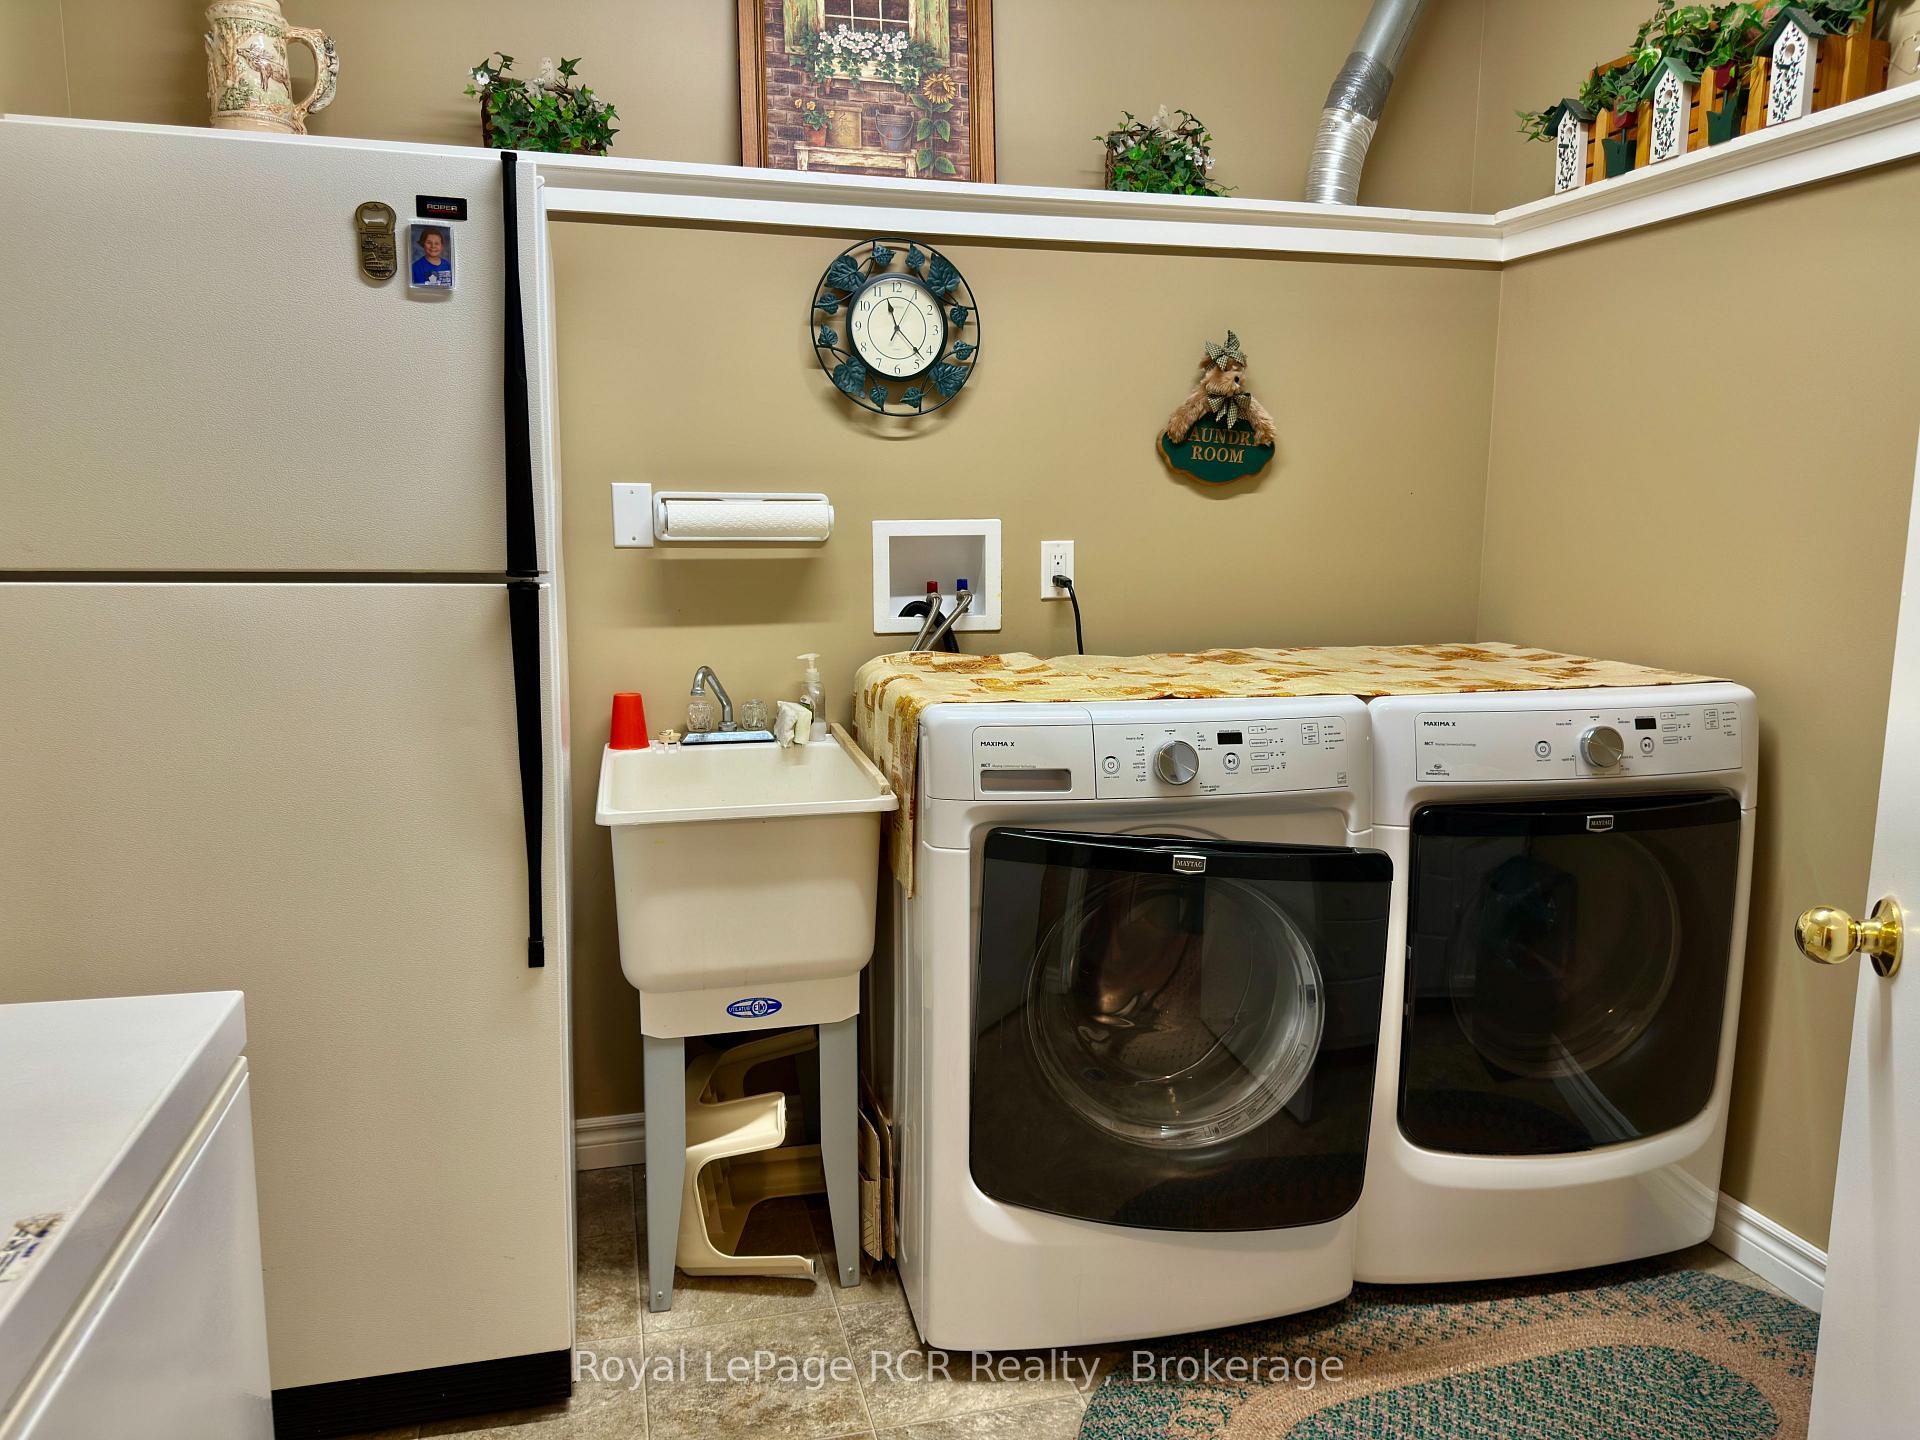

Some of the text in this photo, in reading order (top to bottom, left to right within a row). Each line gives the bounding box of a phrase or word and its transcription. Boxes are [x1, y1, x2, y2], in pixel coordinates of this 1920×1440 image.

[426, 203, 458, 213] ROPER
[873, 286, 882, 297] 11
[892, 282, 902, 293] 12
[860, 300, 871, 311] 10
[927, 305, 933, 315] 2
[855, 321, 862, 331] 9
[933, 325, 939, 336] 3
[860, 342, 867, 352] 8
[926, 345, 933, 355] 4
[875, 357, 882, 368] 7
[913, 359, 920, 370] 5
[894, 364, 901, 374] 6
[1191, 445, 1245, 464] ROOM
[1176, 860, 1203, 868] MAYTAG
